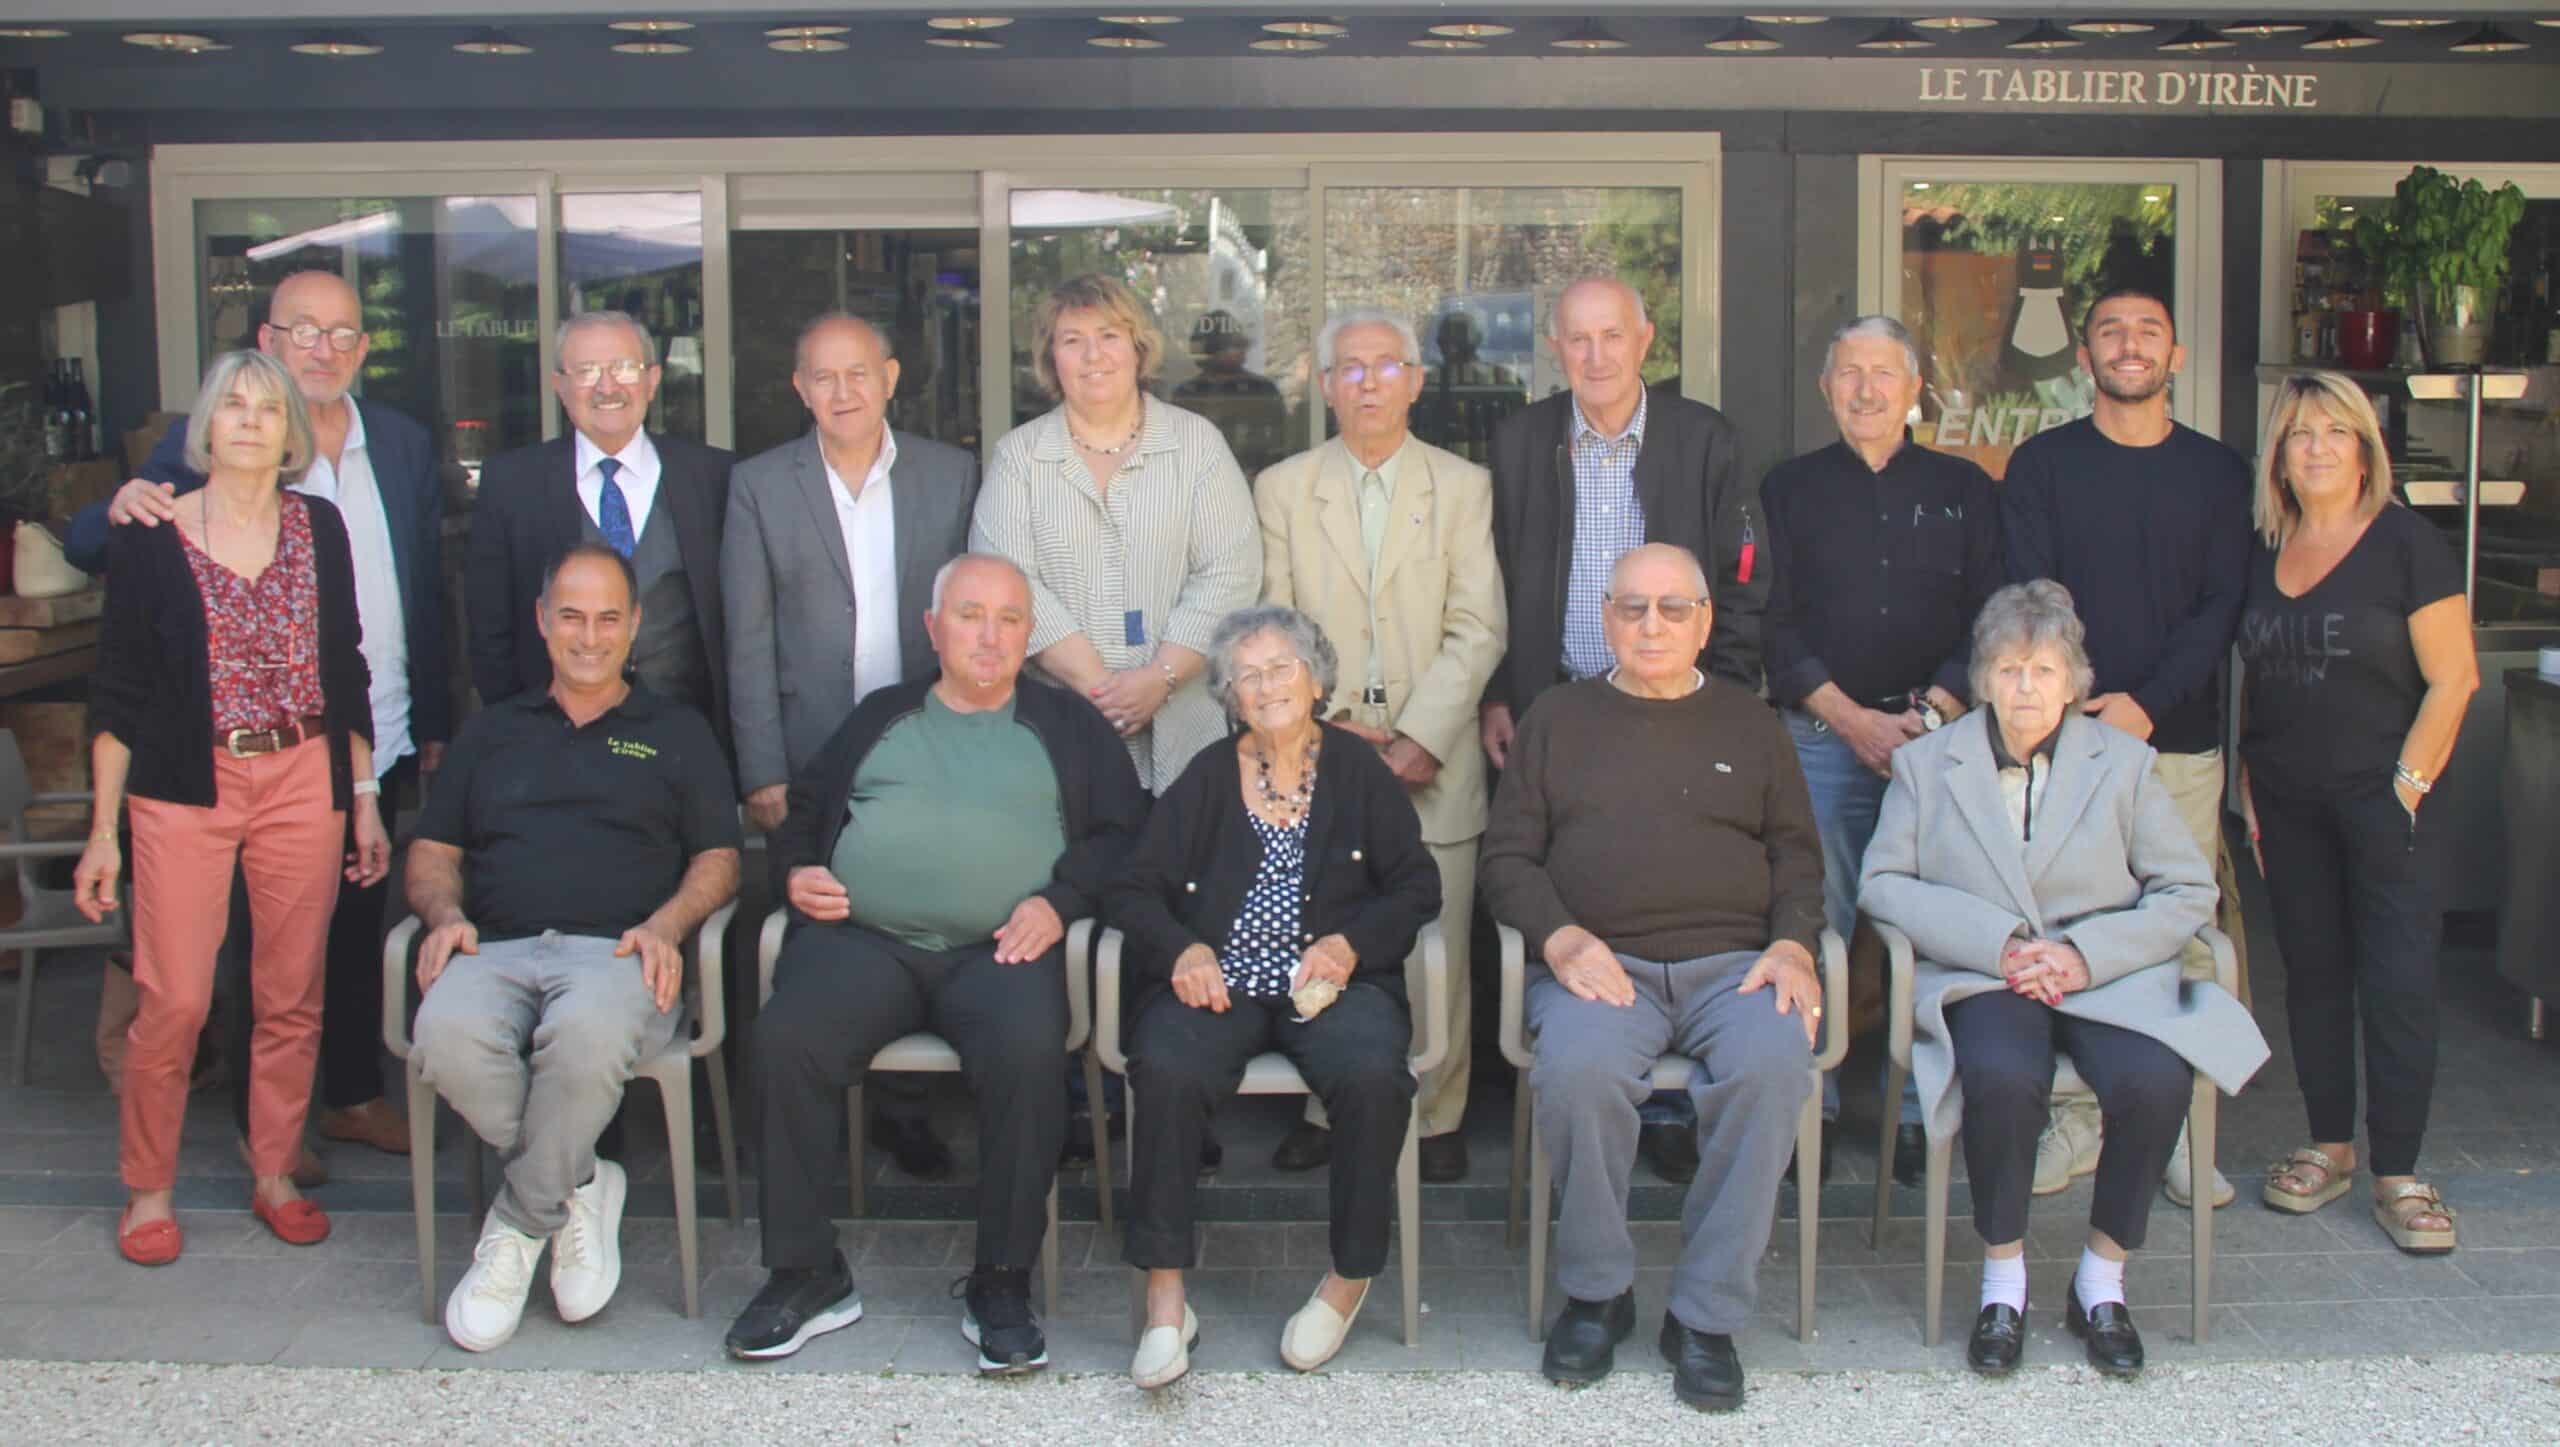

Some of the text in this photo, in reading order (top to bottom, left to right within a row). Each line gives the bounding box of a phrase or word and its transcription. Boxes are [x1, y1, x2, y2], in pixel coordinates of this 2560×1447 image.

[1918, 63, 2318, 107] LE TABLIER D'IRÈNE
[1935, 405, 2074, 446] ENTR
[2242, 611, 2351, 657] SMILE
